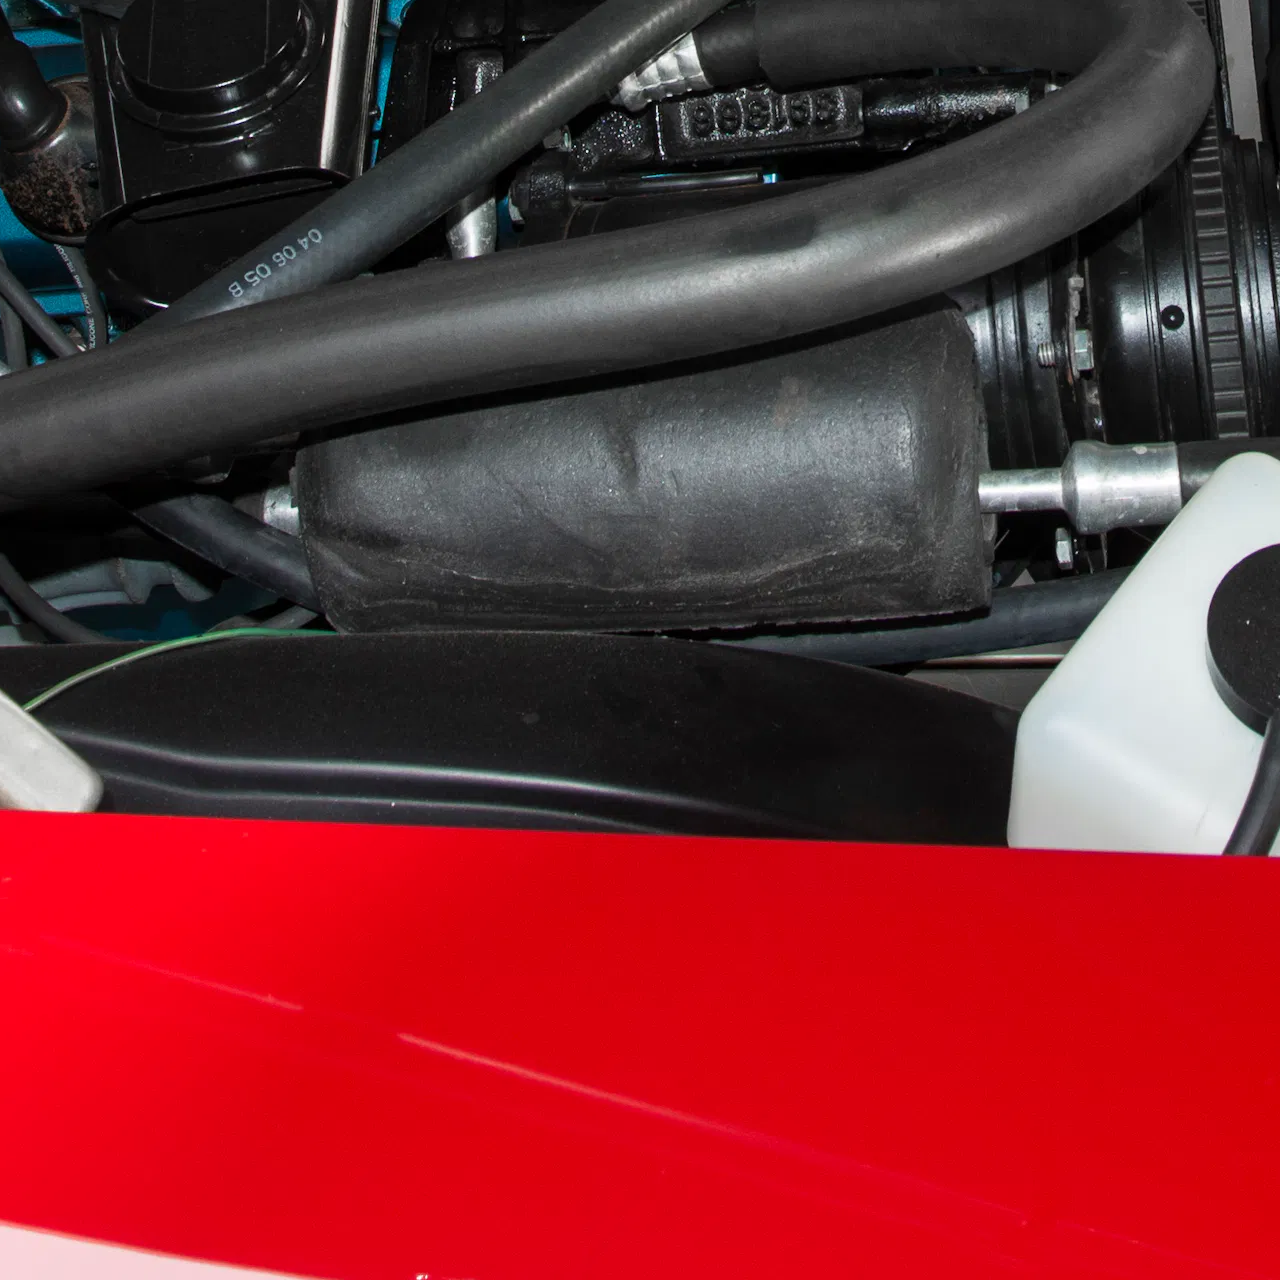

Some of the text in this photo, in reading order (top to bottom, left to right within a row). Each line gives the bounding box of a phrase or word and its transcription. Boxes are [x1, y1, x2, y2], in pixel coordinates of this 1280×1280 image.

[228, 228, 322, 298] 04 06 05 B
